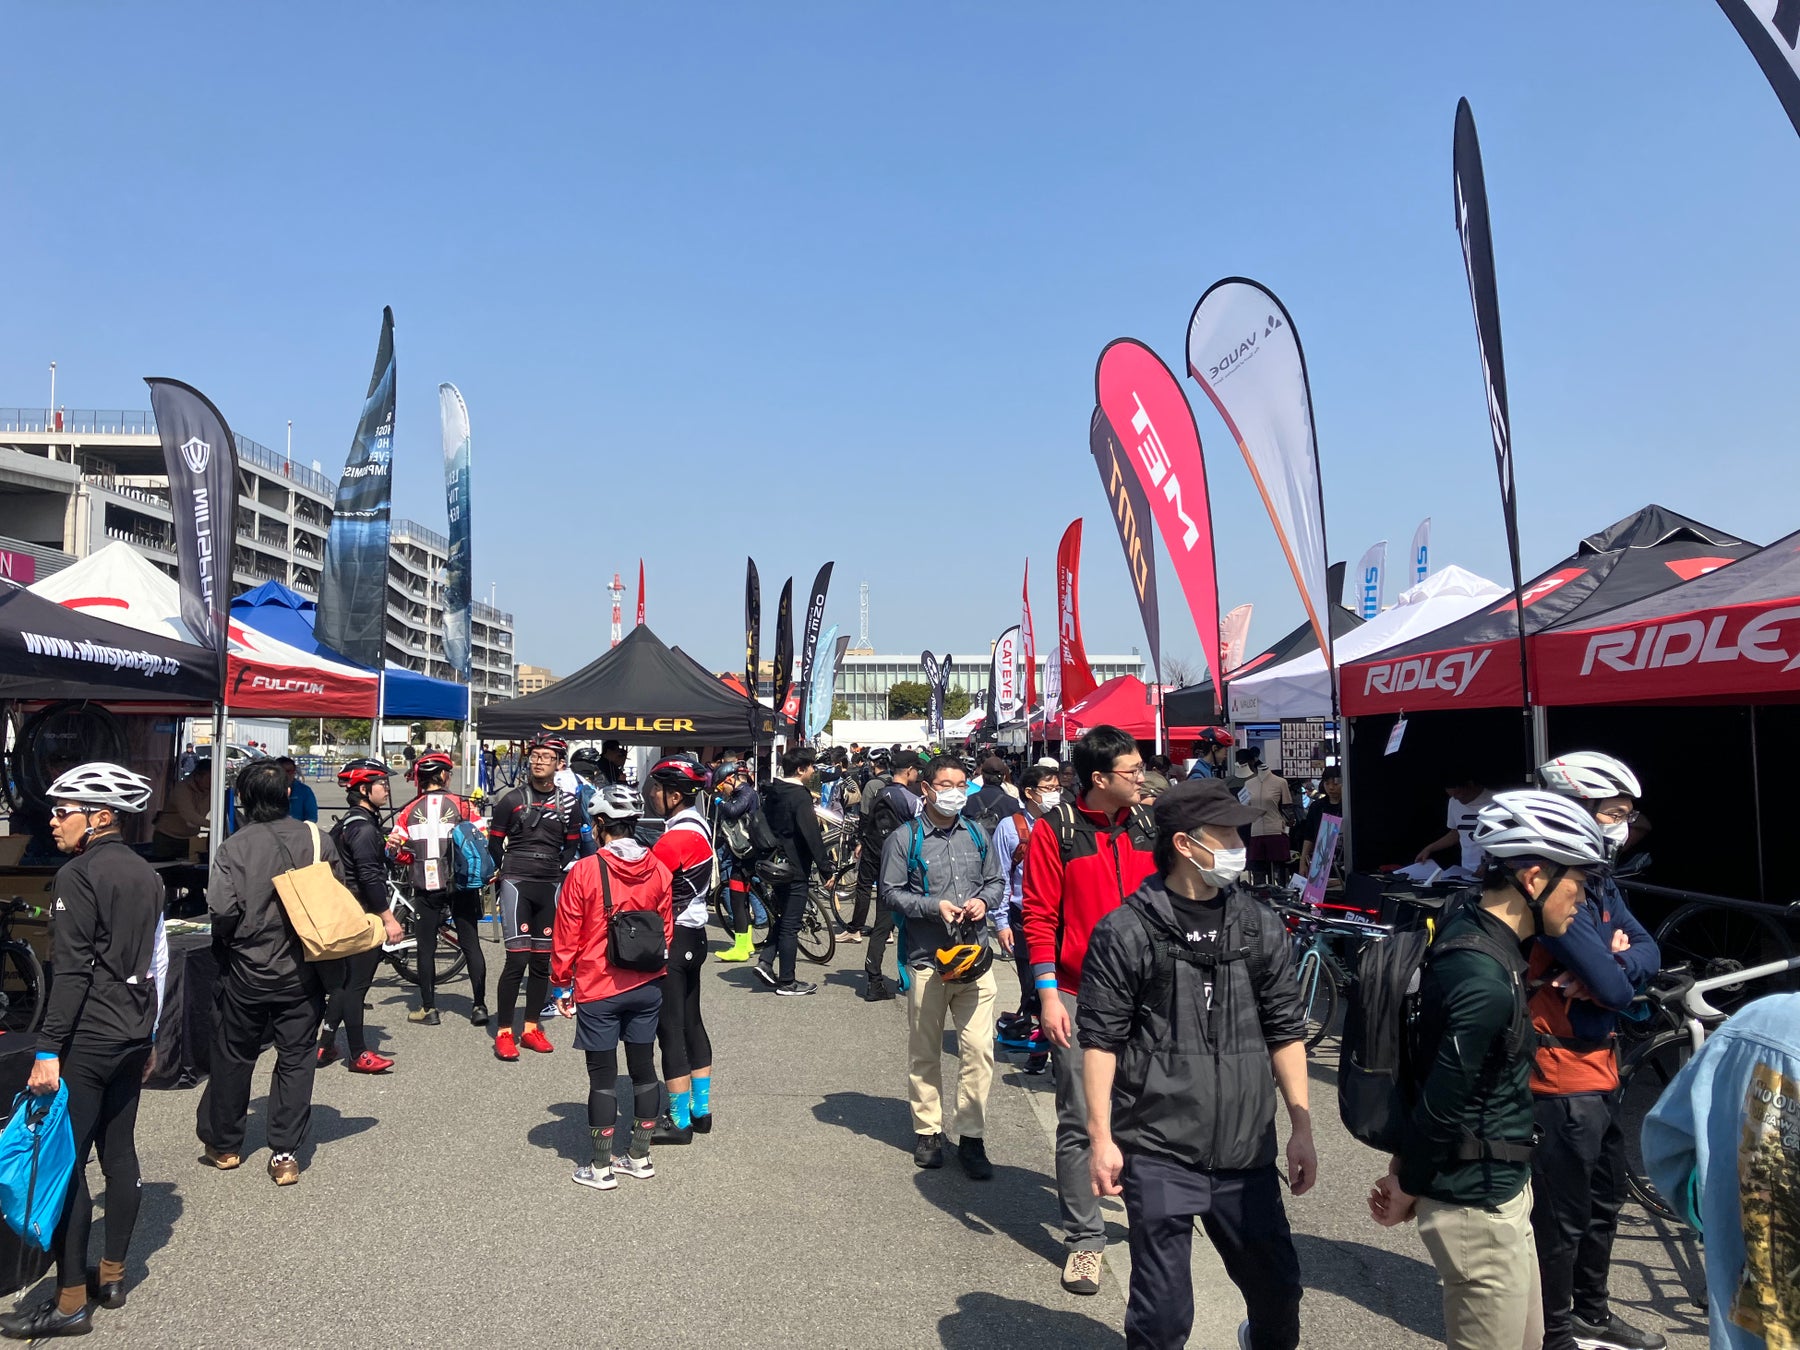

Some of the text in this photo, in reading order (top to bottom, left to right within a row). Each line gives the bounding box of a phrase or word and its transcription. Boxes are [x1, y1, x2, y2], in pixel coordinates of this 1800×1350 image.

[20, 631, 181, 678] www.winspacejp.cc
[1363, 649, 1492, 697] RIDLEY
[566, 716, 698, 733] MULLER
